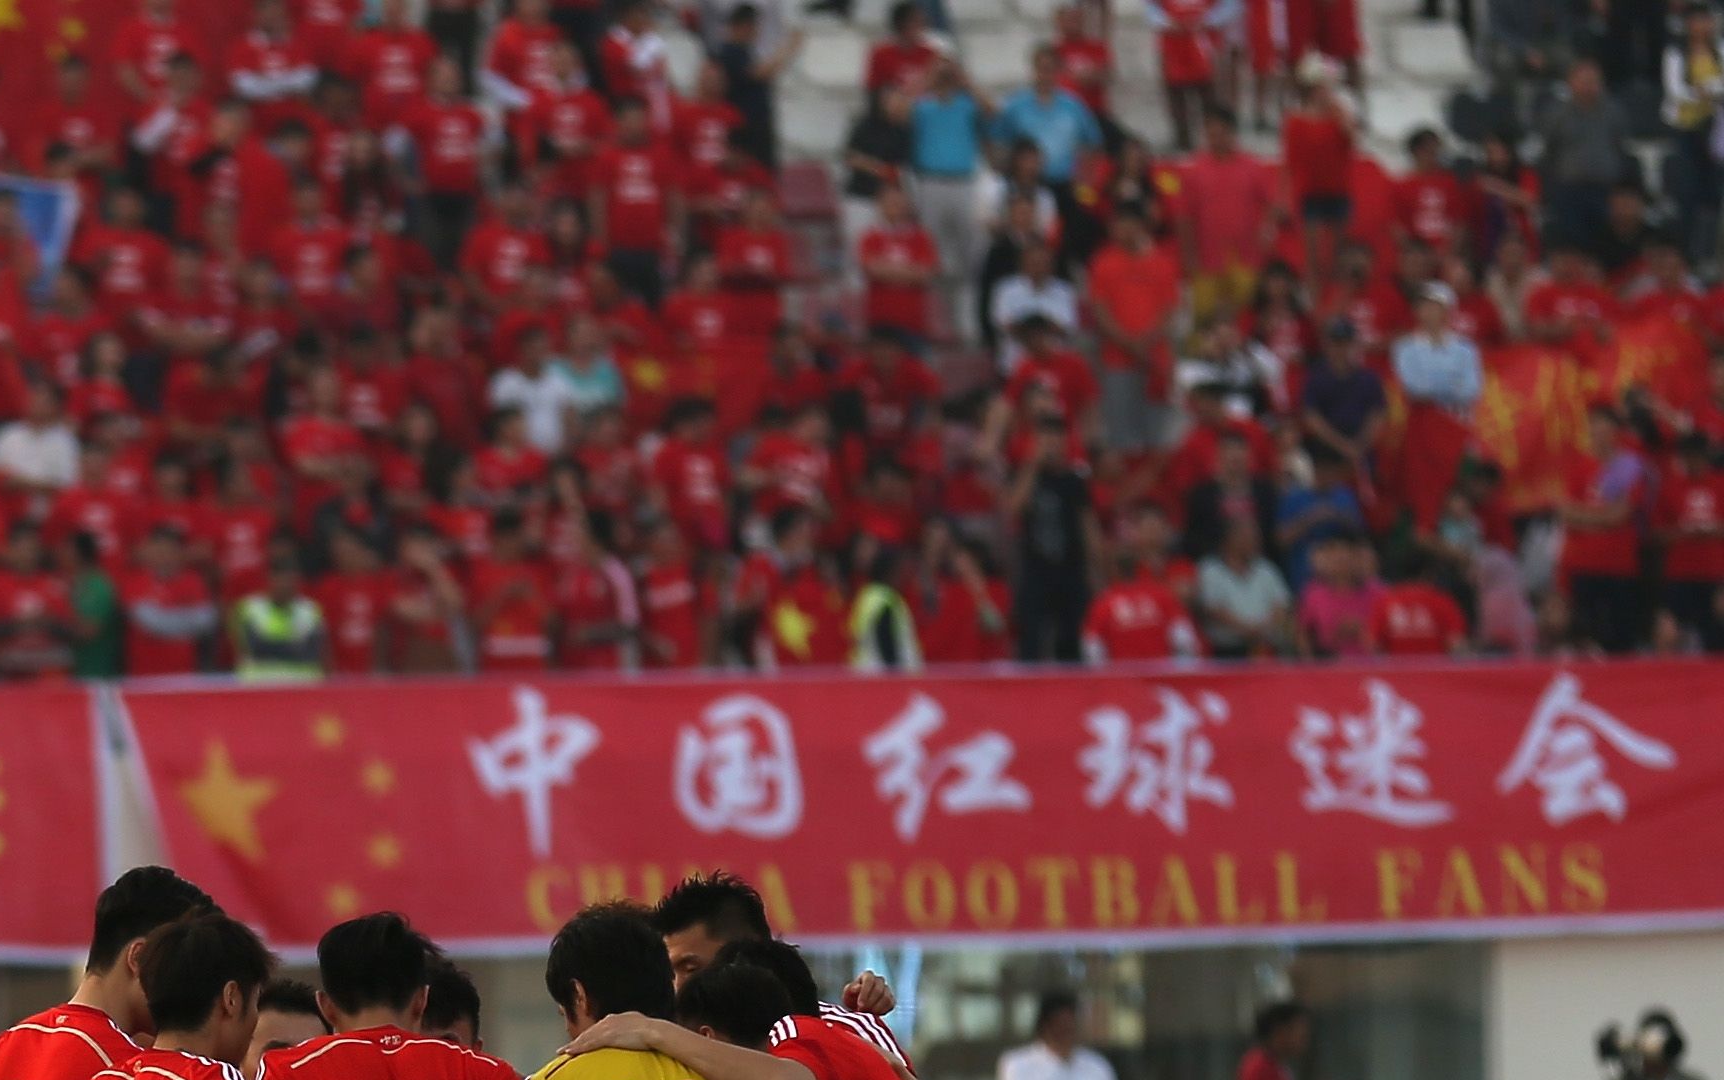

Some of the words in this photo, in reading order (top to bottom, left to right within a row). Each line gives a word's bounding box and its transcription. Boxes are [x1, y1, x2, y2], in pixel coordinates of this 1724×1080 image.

[526, 861, 797, 934] CHIA
[847, 851, 1328, 932] FOOTBALL
[1377, 842, 1610, 921] FANS
